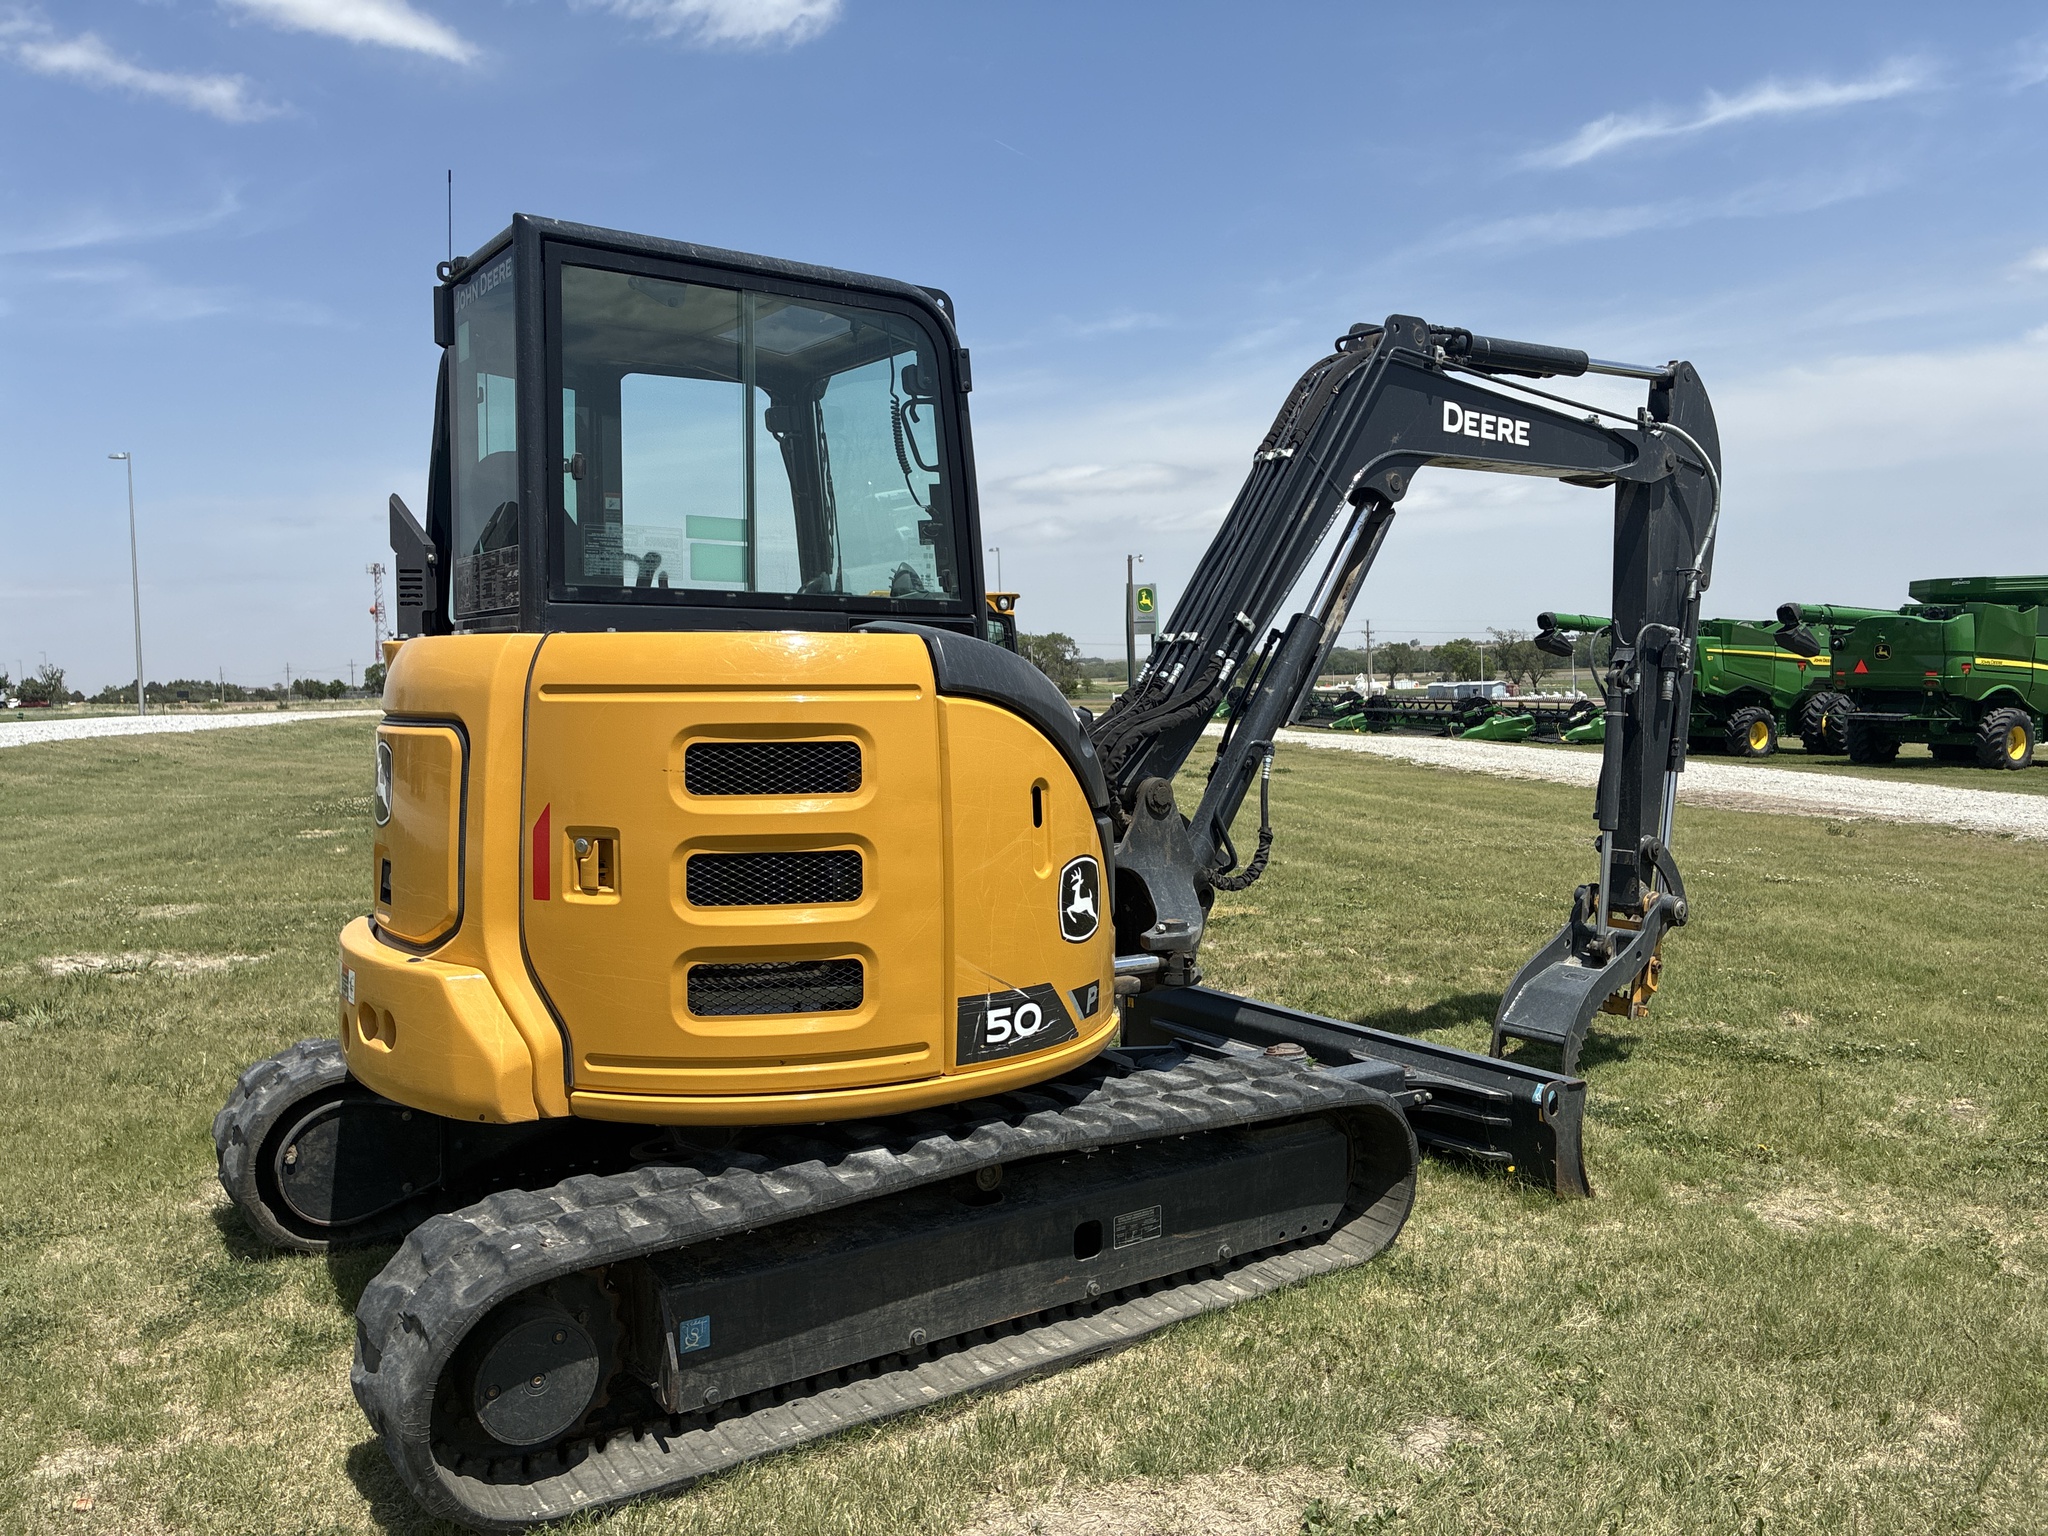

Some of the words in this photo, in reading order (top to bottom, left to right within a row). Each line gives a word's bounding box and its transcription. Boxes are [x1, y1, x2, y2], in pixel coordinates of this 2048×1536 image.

[455, 280, 479, 314] JOHN
[480, 256, 512, 296] DEERE
[1443, 400, 1531, 447] DEERE
[986, 1002, 1043, 1044] 50
